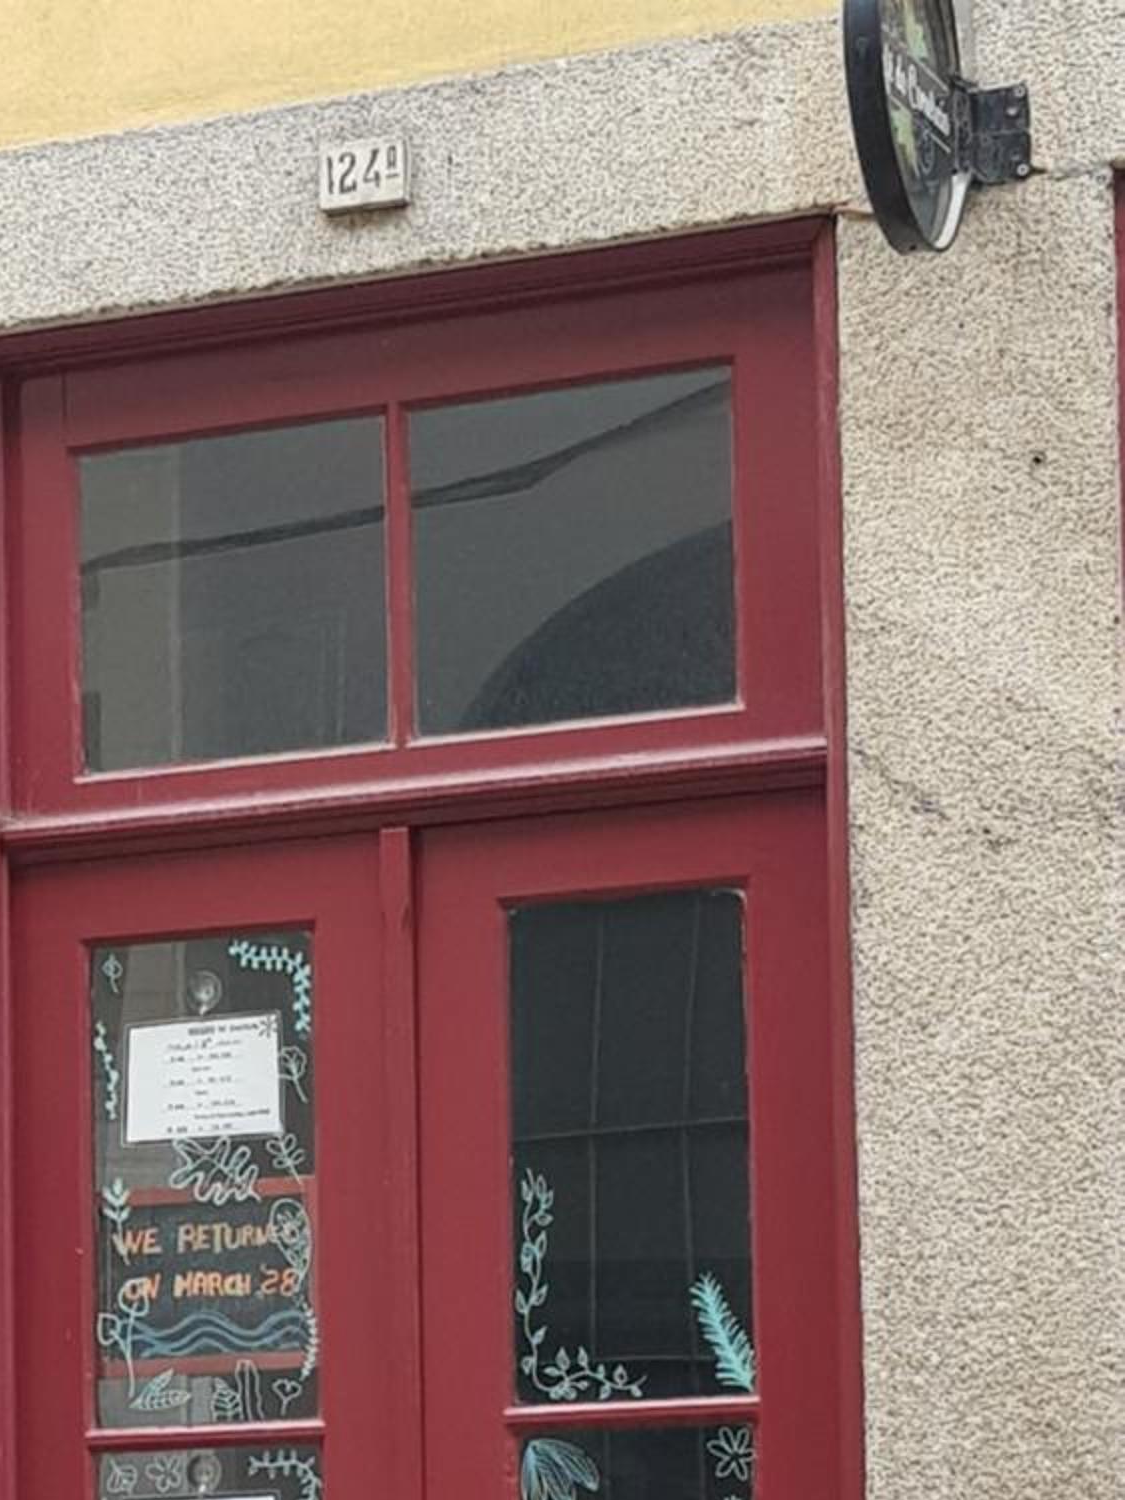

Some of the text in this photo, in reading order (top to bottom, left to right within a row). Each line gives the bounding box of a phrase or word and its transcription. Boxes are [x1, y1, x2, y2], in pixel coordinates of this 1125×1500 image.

[122, 1222, 274, 1255] WE RETURN
[124, 1268, 299, 1300] ON MARCH 28
